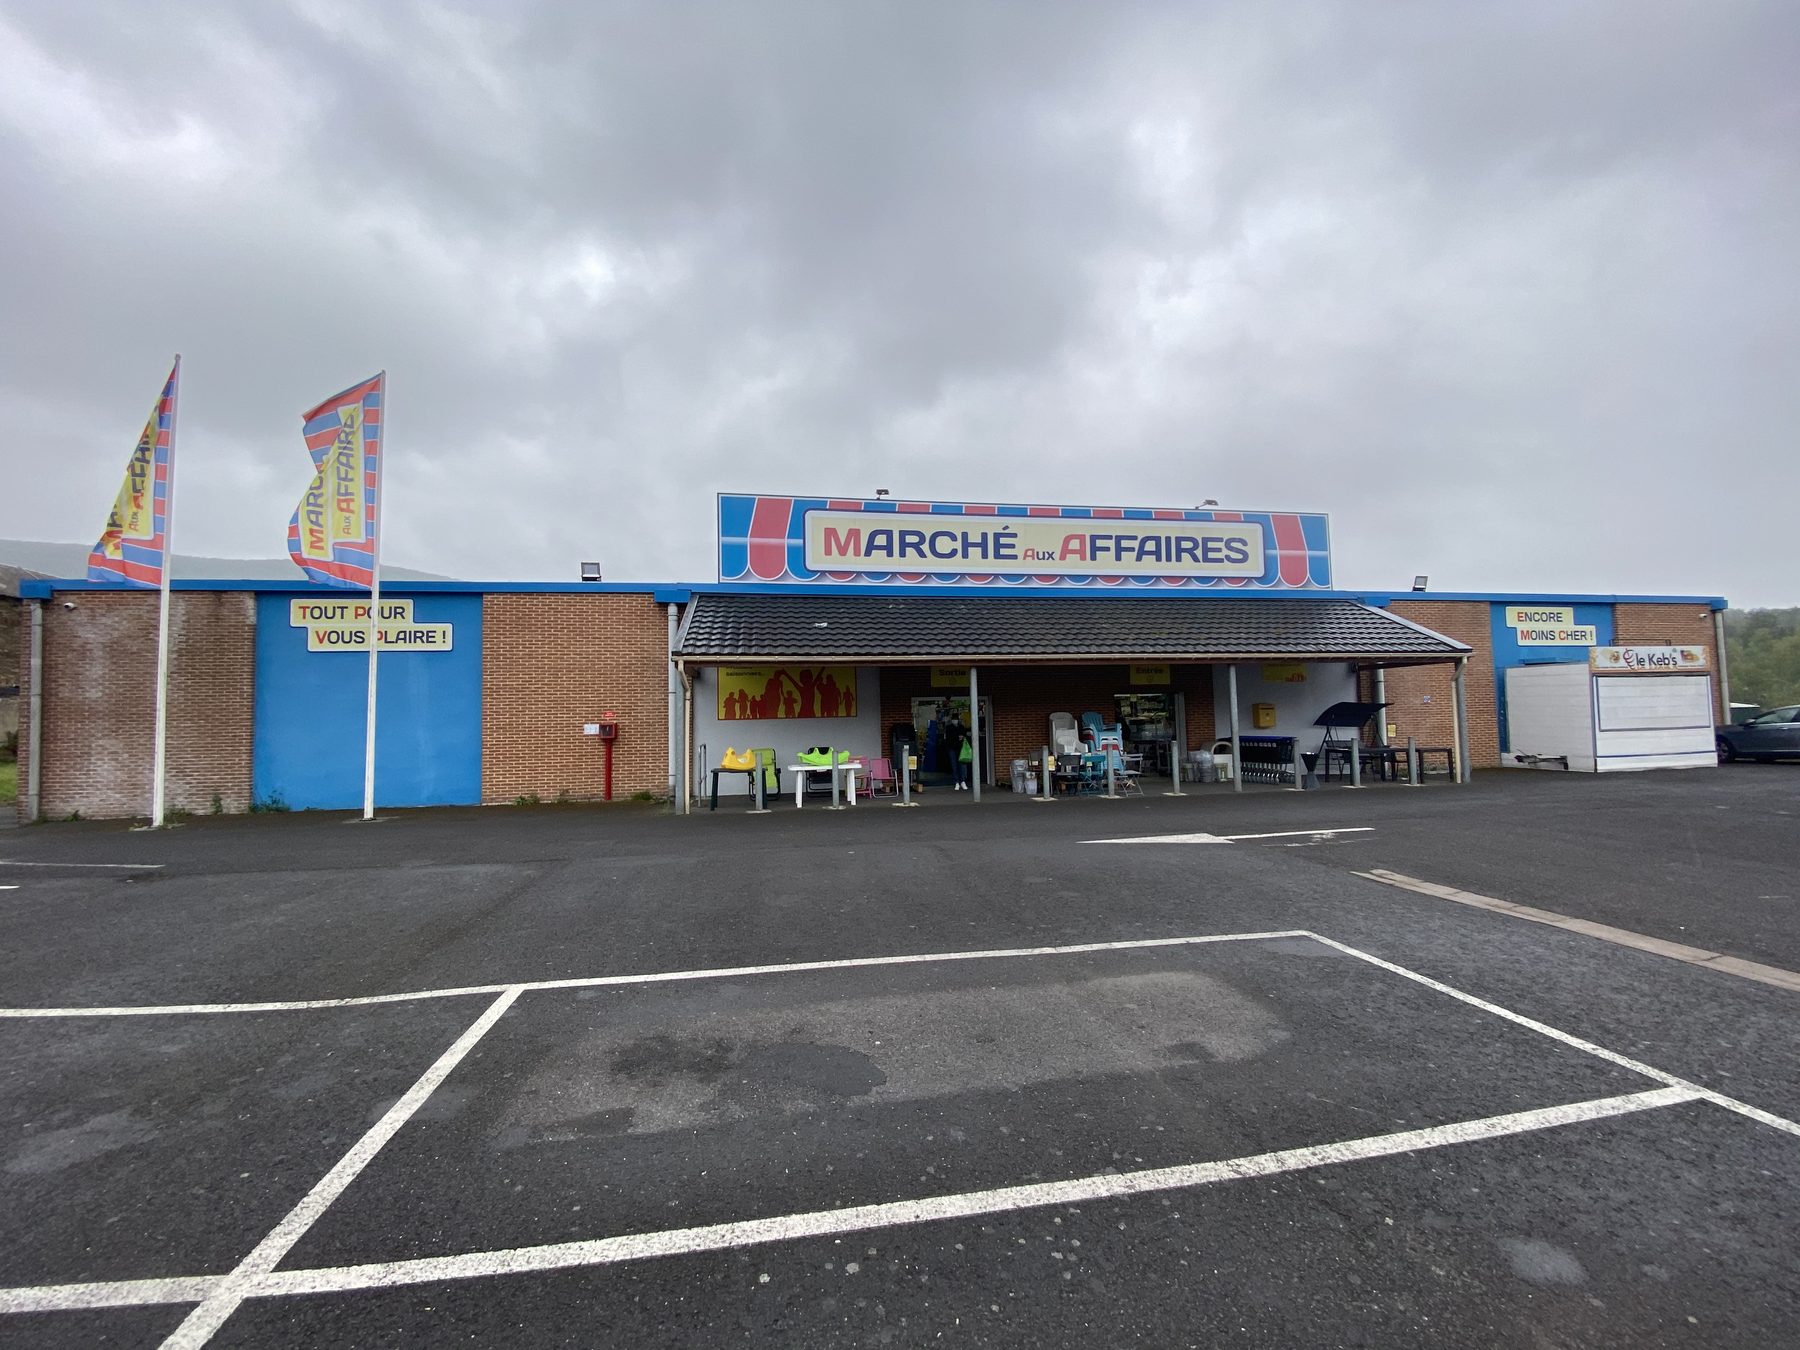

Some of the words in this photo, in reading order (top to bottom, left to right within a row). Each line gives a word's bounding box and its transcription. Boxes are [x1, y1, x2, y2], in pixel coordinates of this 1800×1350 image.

[342, 515, 351, 535] Aux
[823, 525, 1019, 561] MARCHÉ
[1022, 548, 1056, 561] Aux
[1058, 533, 1249, 564] AFFAIRES
[298, 605, 349, 620] TOUT
[1517, 612, 1563, 622] ENCORE
[315, 630, 365, 644] VOUS
[1520, 630, 1556, 641] MOINS
[1558, 630, 1587, 641] CHER
[1648, 653, 1677, 666] Keb's
